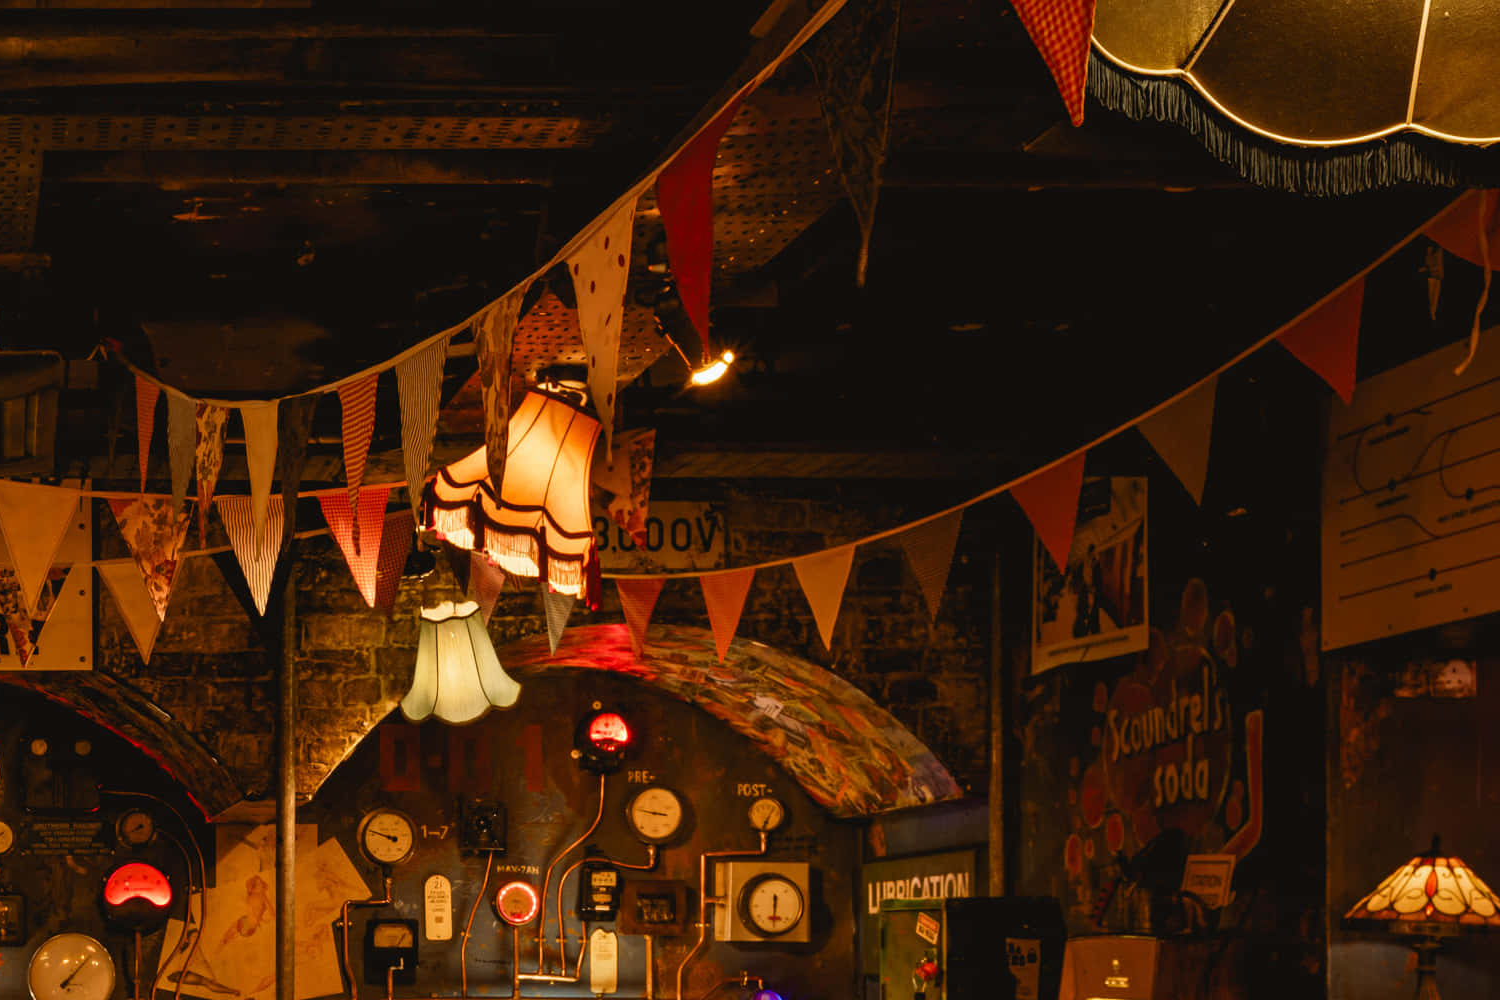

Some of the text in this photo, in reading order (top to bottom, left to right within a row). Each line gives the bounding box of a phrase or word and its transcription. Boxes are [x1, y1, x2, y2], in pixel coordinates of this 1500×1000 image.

[1107, 664, 1224, 764] Scoundrel's
[737, 783, 773, 797] POST-
[1153, 734, 1210, 808] soda
